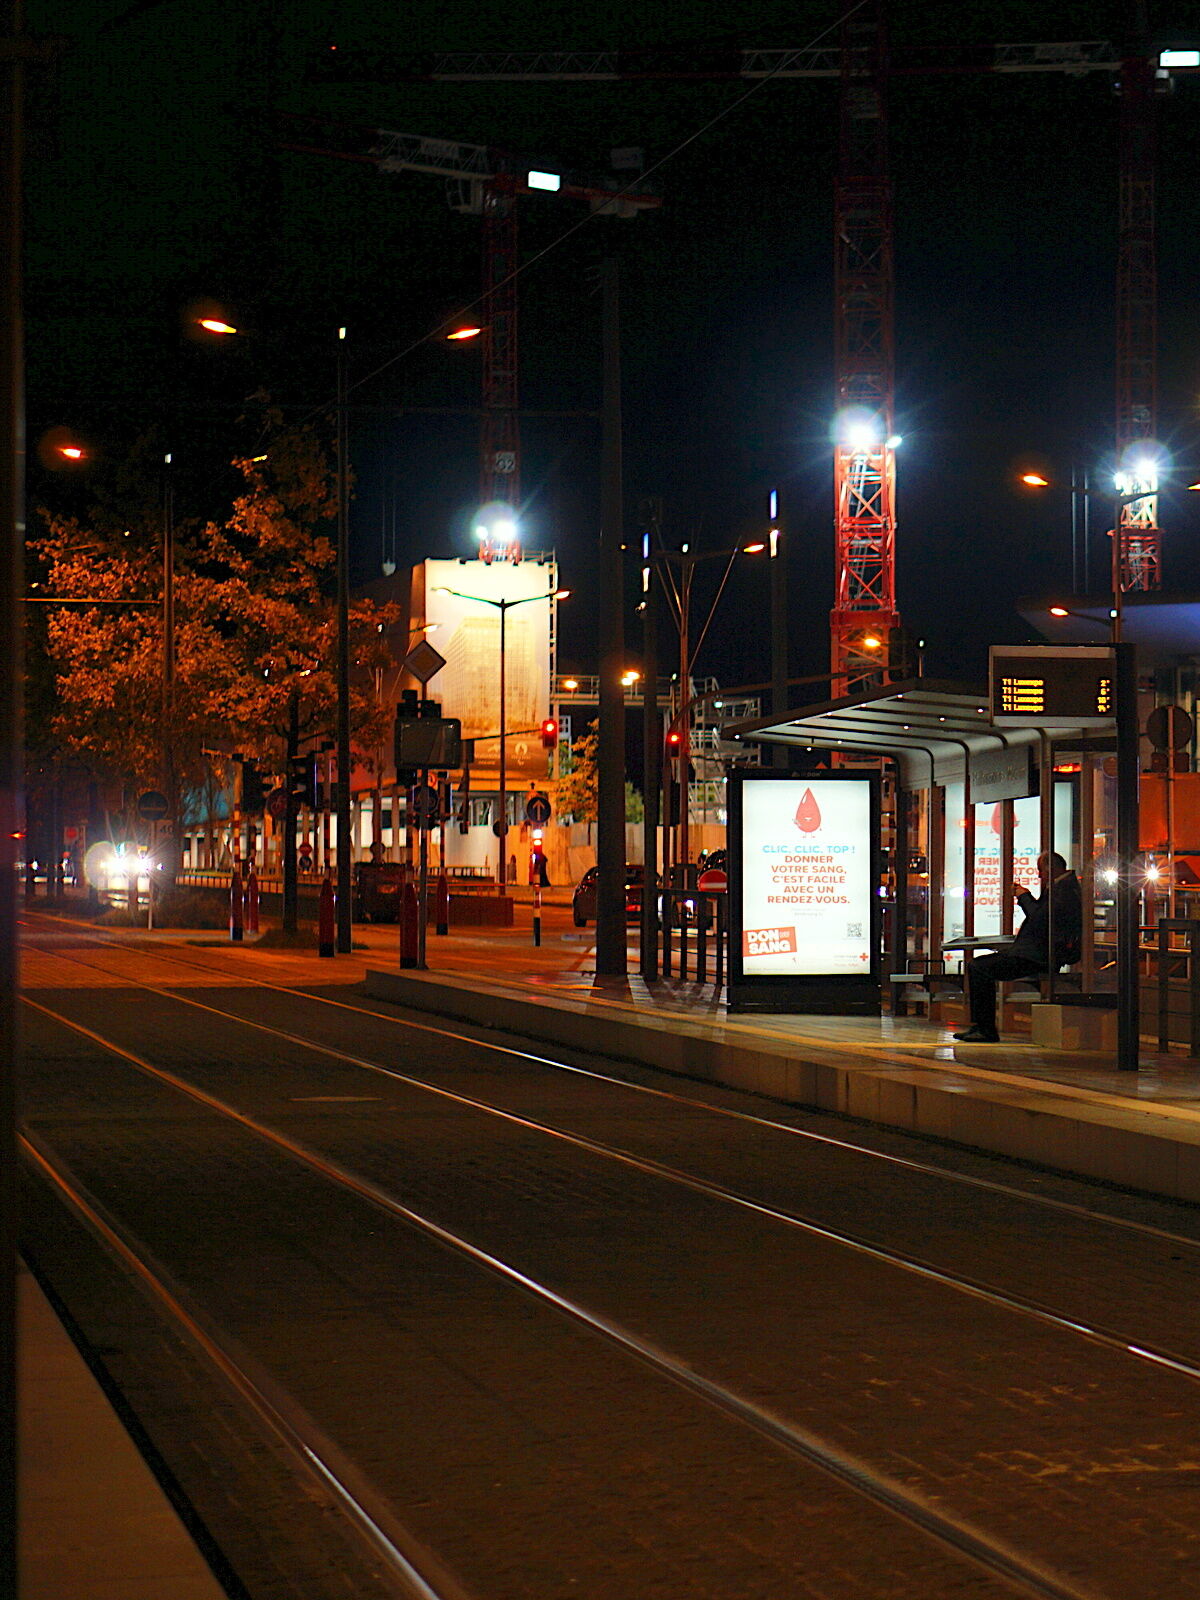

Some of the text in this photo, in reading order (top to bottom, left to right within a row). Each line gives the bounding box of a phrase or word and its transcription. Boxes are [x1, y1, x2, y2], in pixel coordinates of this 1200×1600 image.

[1002, 678, 1012, 686] T1
[1002, 687, 1012, 695] T1
[1002, 695, 1012, 703] T1
[827, 845, 850, 854] TOP
[784, 855, 834, 864] DONNER
[771, 865, 847, 875] VOTRE SANG,
[772, 875, 846, 884] C'EST FACILE
[783, 885, 834, 894] AVEC UN
[767, 895, 851, 904] RENDEZ-VOUS.
[747, 929, 779, 943] DON
[748, 940, 791, 954] SANG
